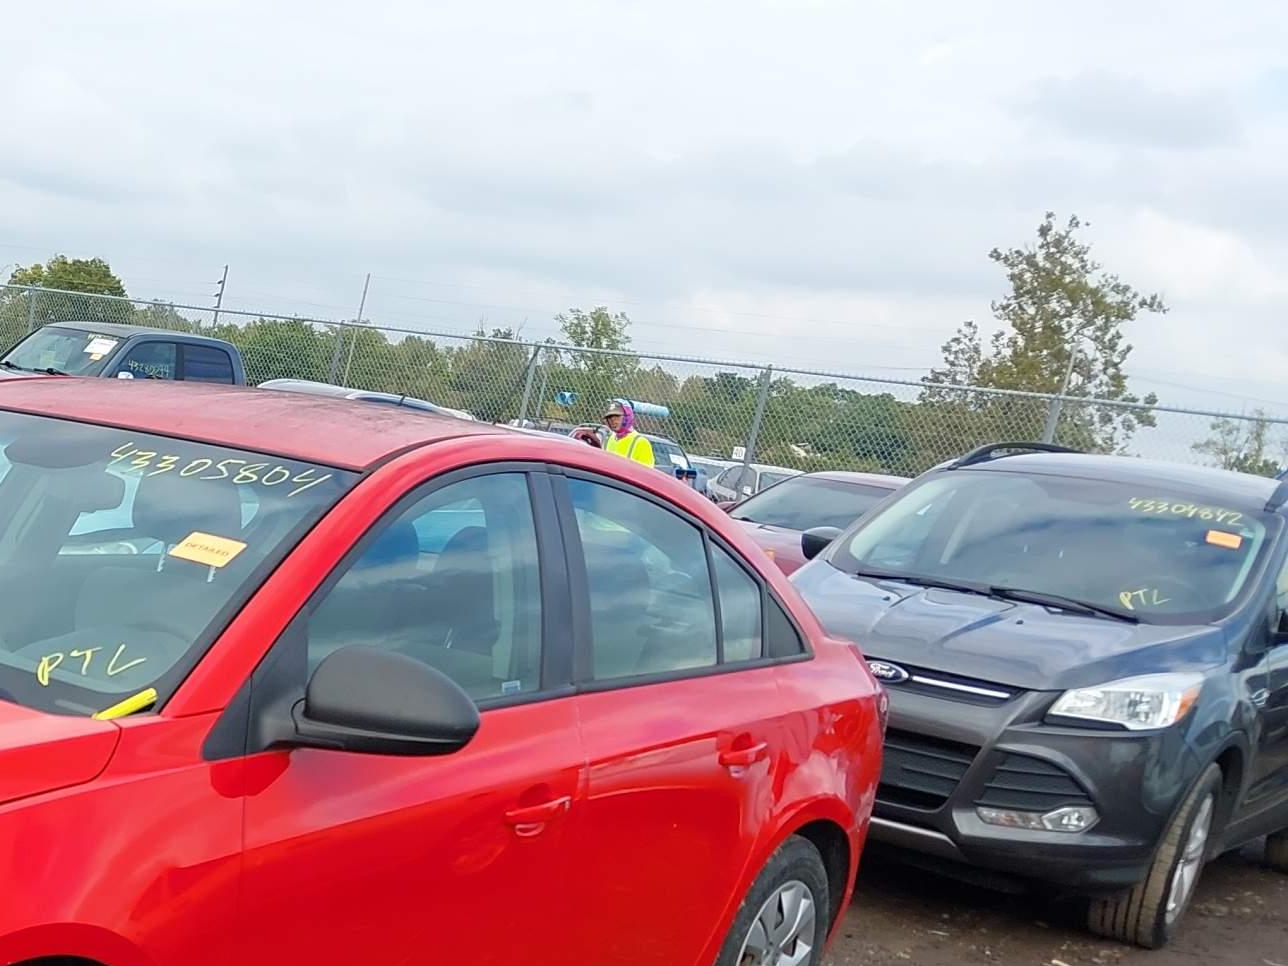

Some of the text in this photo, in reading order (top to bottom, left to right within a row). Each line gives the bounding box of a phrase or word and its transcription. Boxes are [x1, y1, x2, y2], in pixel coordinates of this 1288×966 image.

[105, 442, 333, 497] 43305804
[1119, 588, 1172, 610] PTL
[869, 663, 896, 679] Ford
